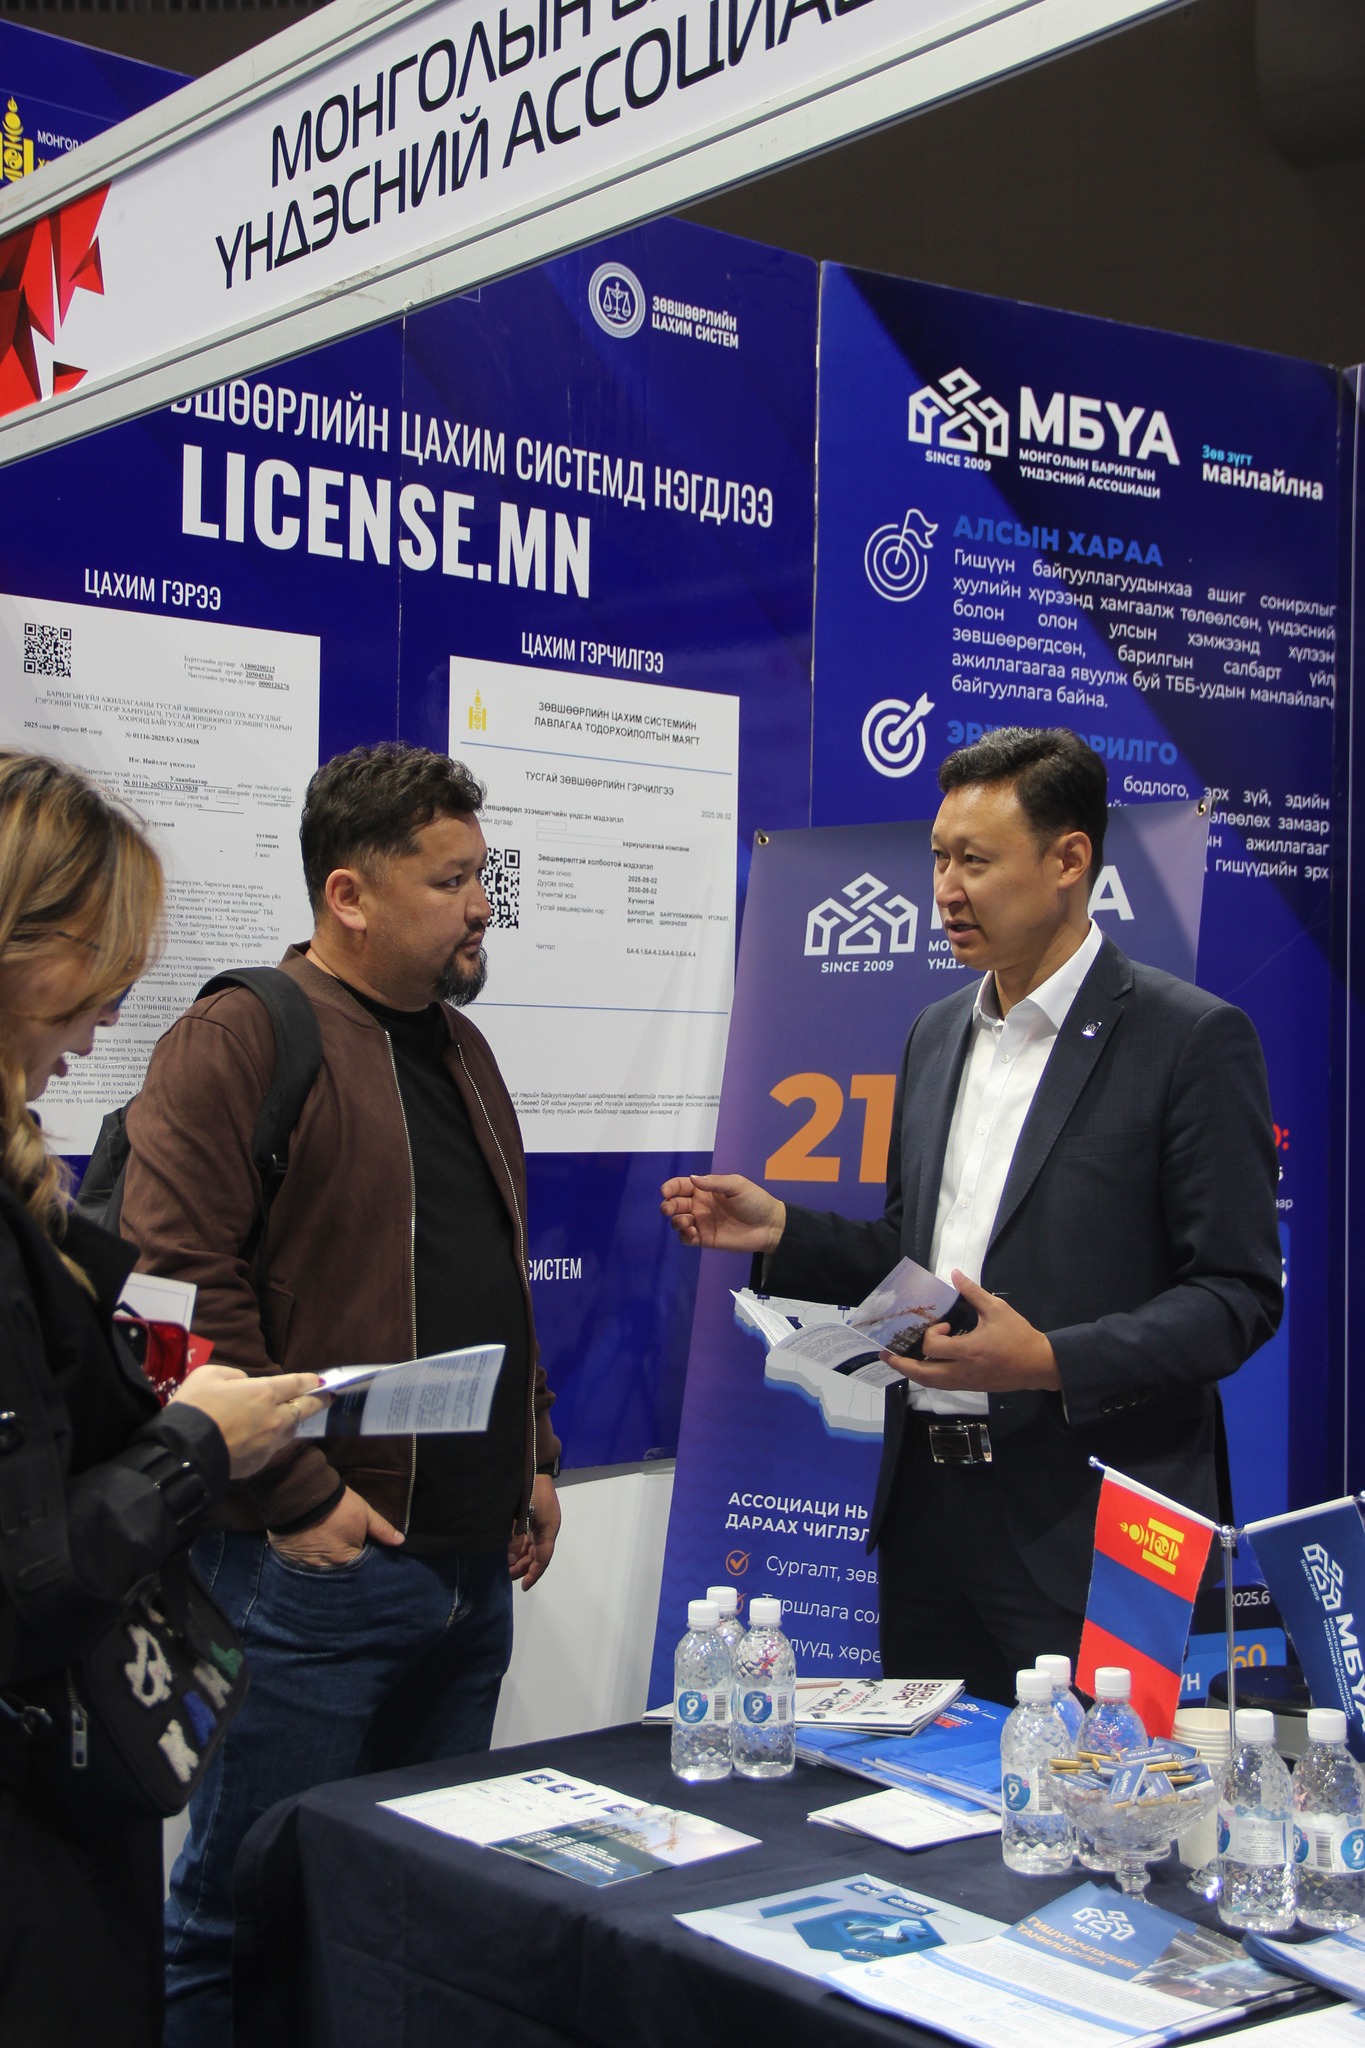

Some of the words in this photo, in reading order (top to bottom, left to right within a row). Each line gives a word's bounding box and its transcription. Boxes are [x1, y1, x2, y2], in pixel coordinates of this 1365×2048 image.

[271, 0, 591, 188] МОНГОЛЫН
[37, 129, 84, 151] МОНГОЛ
[215, 112, 488, 290] ҮНДЭСНИЙ
[502, 0, 875, 169] АССОЦИ
[652, 295, 738, 332] ЗӨВШӨӨРЛИЙН
[651, 313, 693, 338] ЦАХИМ
[696, 325, 739, 349] СИСТЕМ
[1019, 386, 1181, 466] МБҮА
[401, 411, 507, 475] ЦАХИМ
[516, 437, 645, 511] СИСТЕМД
[654, 466, 774, 529] НЭГДЛЭЭ
[925, 449, 961, 468] SINCE
[963, 456, 992, 472] 2009
[1019, 448, 1089, 472] МОНГОЛЫН
[1091, 458, 1156, 482] БАРИЛГЫН
[1202, 444, 1224, 462] Зөв
[1226, 451, 1253, 467] зүгт
[1019, 465, 1085, 488] ҮНДЭСНИЙ
[1087, 476, 1161, 499] АССОЦИАЦИ
[181, 443, 591, 600] LICENSE.MN
[952, 515, 1059, 552] АЛСЫН
[1067, 530, 1164, 567] ХАРАА
[84, 568, 156, 602] ЦАХИМ
[162, 579, 222, 611] ГЭРЭЭ
[954, 548, 1016, 575] Гишүүн
[1032, 559, 1193, 598] байгууллагуудынхаа
[1207, 587, 1246, 605] ашиг
[1260, 594, 1337, 617] сонирхлыг
[953, 576, 1021, 598] хуулийн
[1028, 586, 1094, 611] хүрээнд
[1100, 596, 1175, 620] хамгаалж
[1180, 606, 1263, 634] төлөөлсөн,
[1267, 619, 1336, 641] үндэсний
[953, 598, 1005, 622] болон
[1037, 613, 1078, 631] олон
[1109, 622, 1157, 641] улсын
[1187, 632, 1261, 656] хэмжээнд
[1288, 645, 1336, 664] хүлээн
[521, 631, 576, 662] ЦАХИМ
[580, 641, 664, 674] ГЭРЧИЛГЭЭ
[952, 626, 1087, 659] зөвшөөрөгдсөн,
[1117, 644, 1194, 669] барилгын
[1223, 660, 1282, 682] салбарт
[1308, 671, 1335, 687] үйл
[951, 674, 1053, 702] байгууллага
[1056, 685, 1109, 708] байна.
[952, 652, 1066, 679] ажиллагаагаа
[1070, 667, 1128, 686] явуулж
[1132, 669, 1160, 692] буй
[1165, 673, 1246, 700] ТББ-уудын
[1250, 687, 1335, 711] манлайлагч
[533, 716, 583, 732] ЛАВЛАГАА
[672, 733, 701, 746] МАЯГТ
[538, 701, 610, 720] ЗӨВШӨӨРЛИЙН
[611, 710, 643, 724] ЦАХИМ
[644, 714, 698, 731] СИСТЕМИЙН
[525, 770, 558, 784] ТУСГАЙ
[626, 781, 675, 796] ГЭРЧИЛГЭЭ
[1123, 776, 1190, 800] бодлого,
[1203, 787, 1230, 802] эрх
[1242, 789, 1272, 808] зүй,
[1285, 793, 1330, 811] эдийн
[1209, 811, 1271, 829] өлөөлөх
[1277, 817, 1330, 836] замаар
[1245, 837, 1330, 856] ажиллагааг
[1215, 858, 1298, 878] гишүүдийн
[1303, 866, 1329, 882] эрх
[821, 960, 859, 974] SINCE
[863, 959, 894, 972] 2009
[764, 1072, 897, 1184] 21
[728, 1491, 840, 1519] АССОЦИАЦИ
[844, 1504, 869, 1520] НЬ
[725, 1513, 799, 1535] ДАРААХ
[766, 1555, 841, 1583] Сургалт,
[845, 1567, 880, 1585] зөв
[762, 1592, 849, 1620] ршлага
[686, 1698, 699, 1716] 9
[751, 1698, 764, 1716] 9
[1008, 1782, 1020, 1801] 9
[1352, 1839, 1365, 1861] 9
